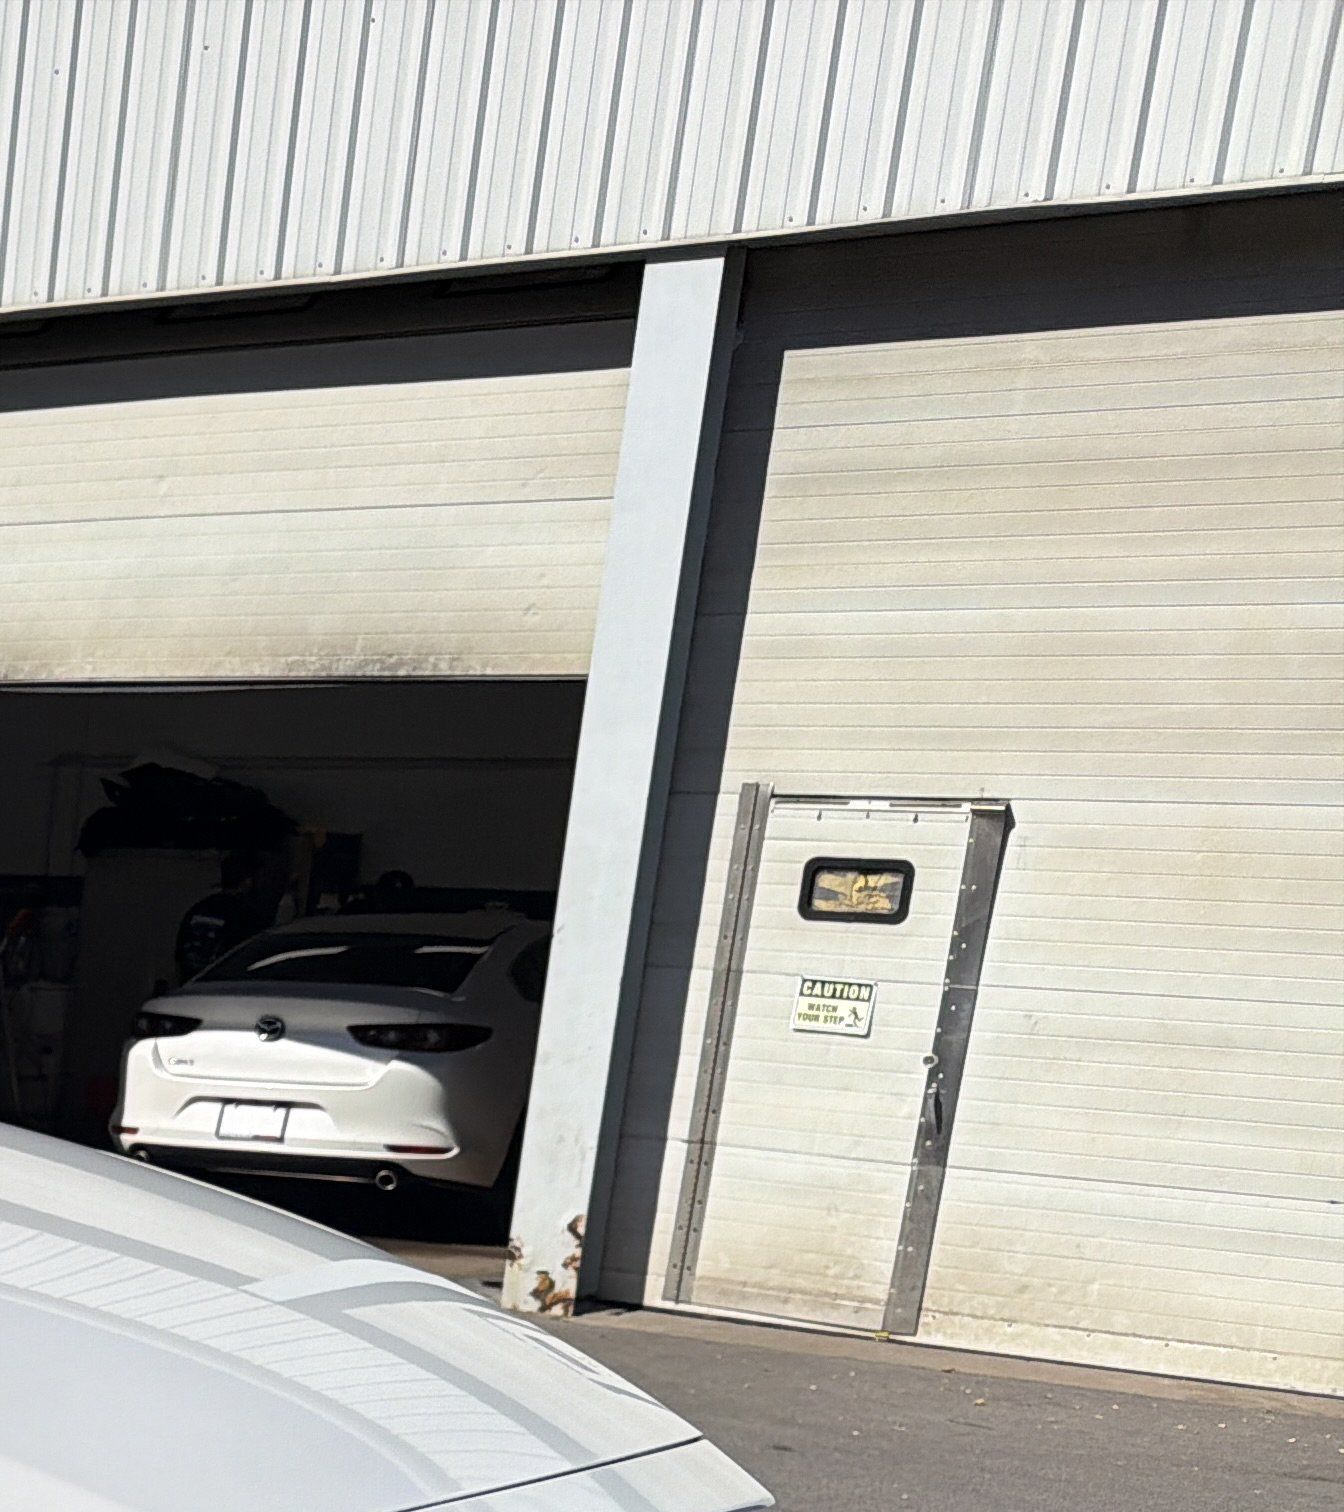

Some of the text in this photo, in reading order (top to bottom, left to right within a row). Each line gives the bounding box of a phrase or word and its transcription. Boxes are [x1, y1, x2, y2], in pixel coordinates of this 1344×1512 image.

[802, 981, 870, 1000] CAUTION
[807, 1003, 838, 1013] WATCH
[798, 1012, 845, 1025] YOUR STEP
